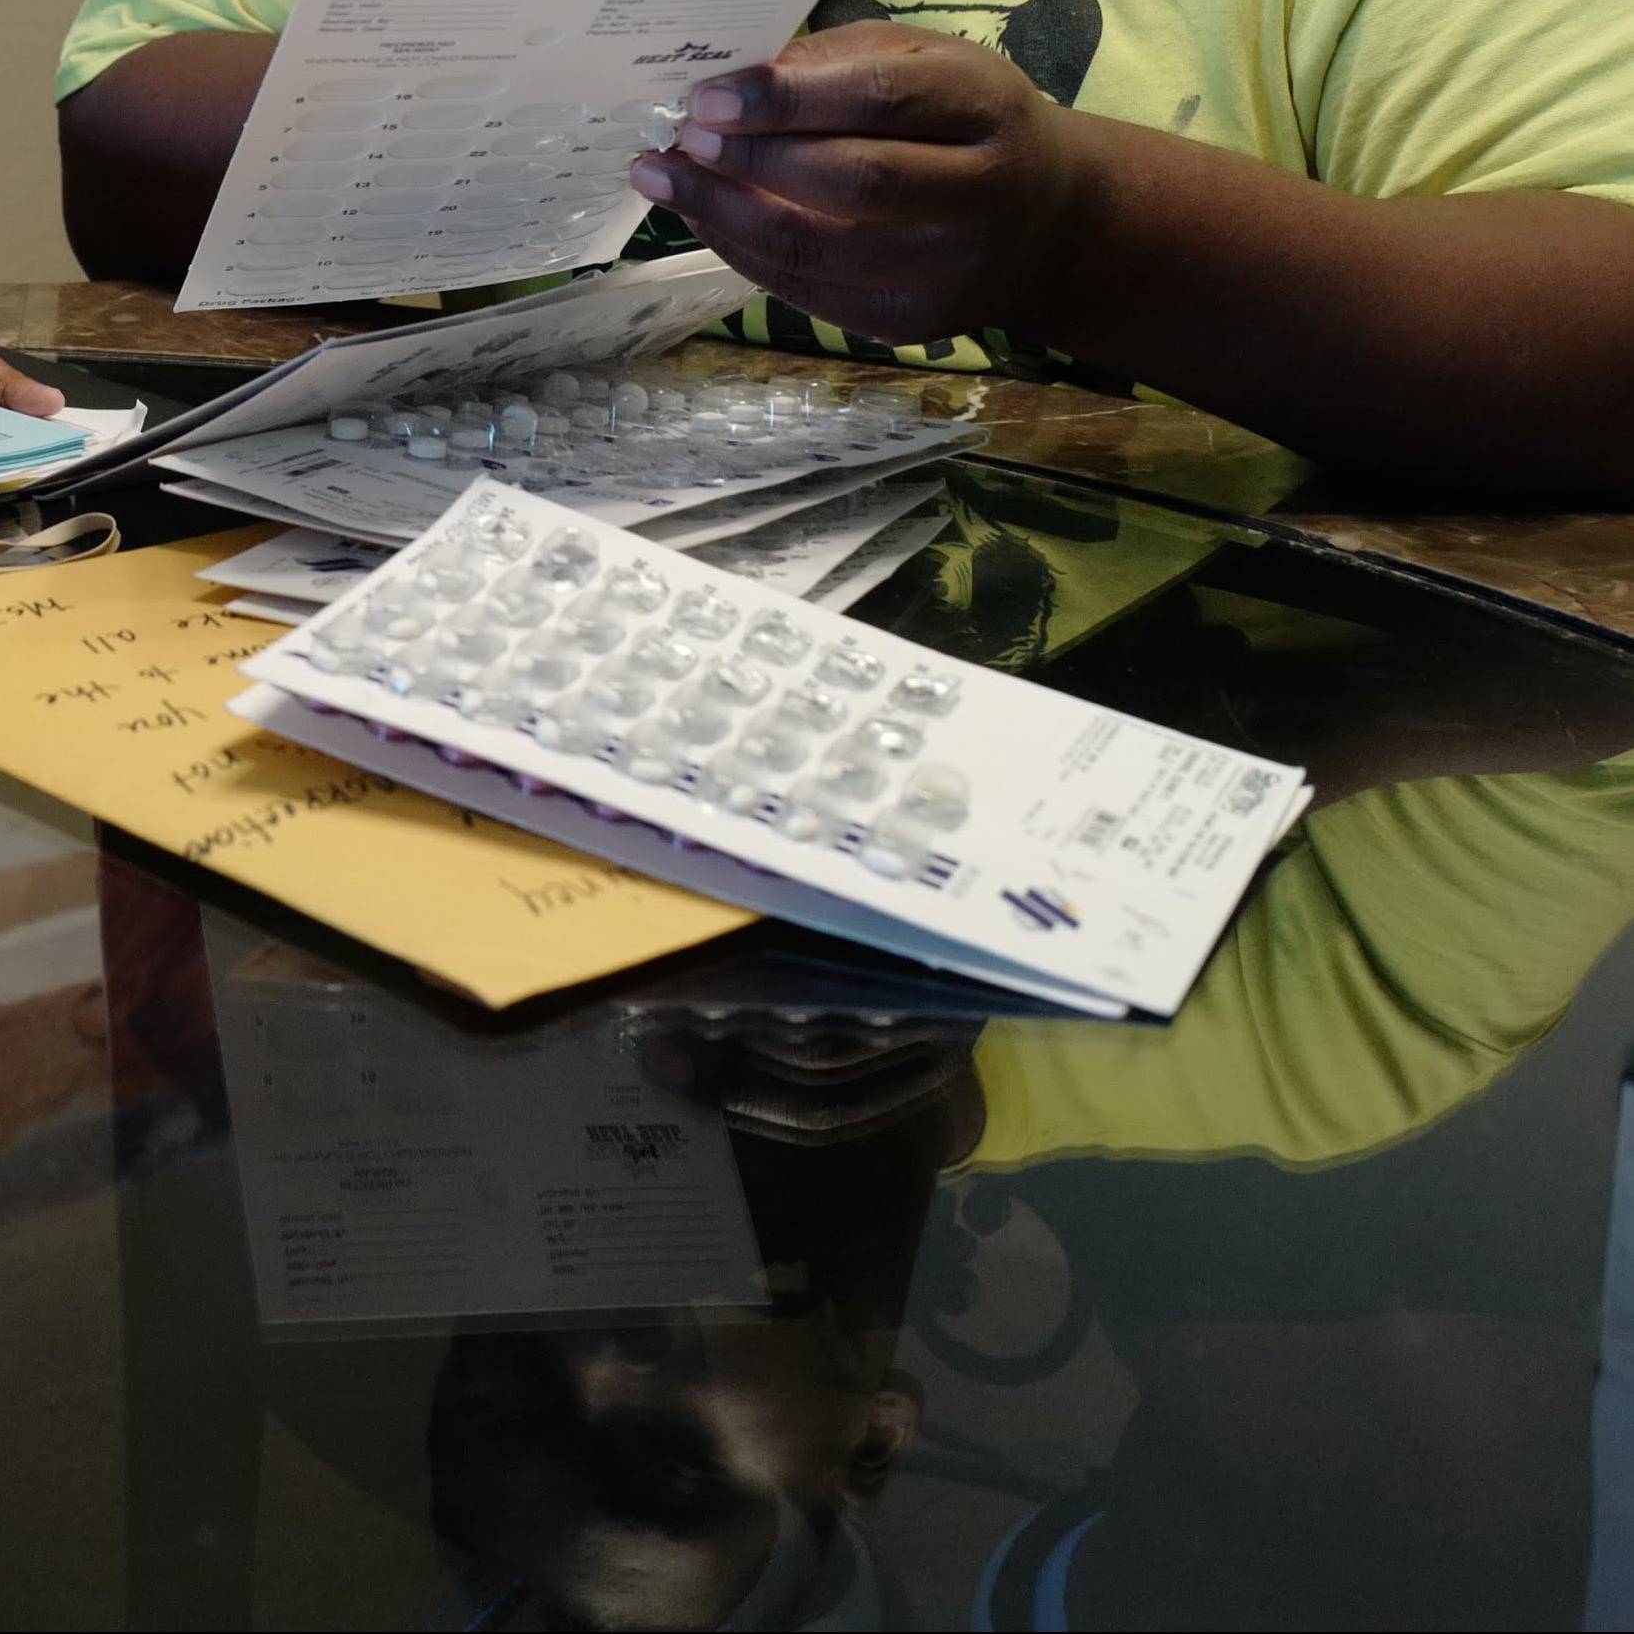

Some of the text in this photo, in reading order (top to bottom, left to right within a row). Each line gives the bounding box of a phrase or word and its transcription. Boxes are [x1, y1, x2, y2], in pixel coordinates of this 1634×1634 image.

[631, 50, 734, 65] HEAT SEAL
[198, 296, 306, 308] Drug Package
[0, 597, 77, 618] Ms.
[82, 629, 137, 655] all
[138, 664, 180, 683] to
[33, 681, 119, 704] the
[171, 747, 243, 794] not
